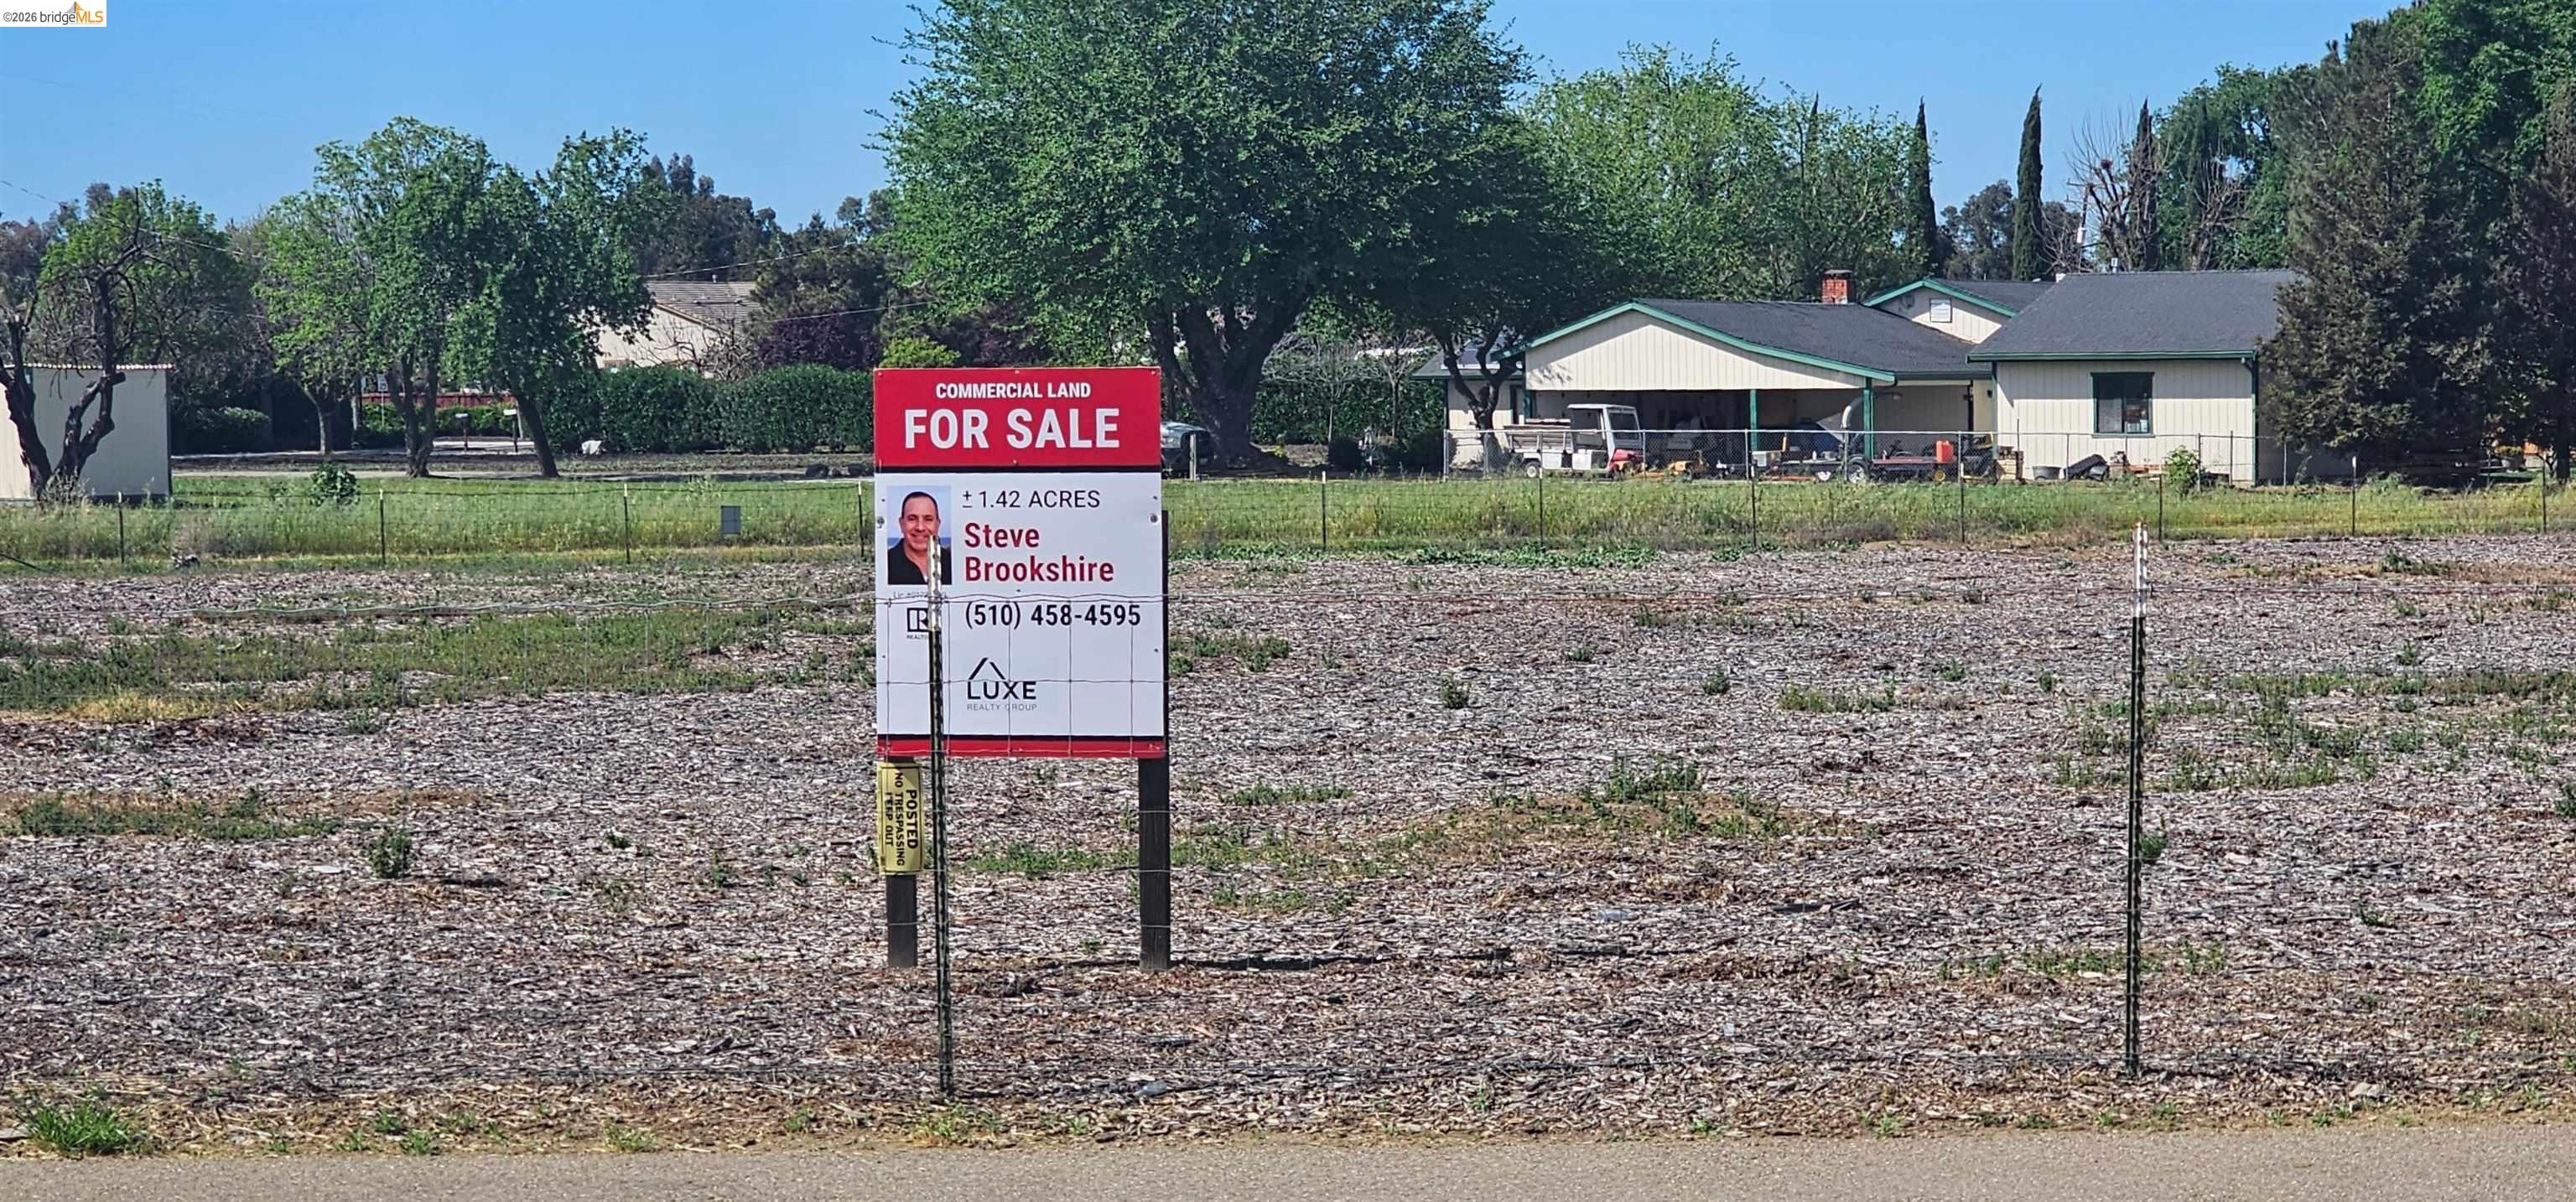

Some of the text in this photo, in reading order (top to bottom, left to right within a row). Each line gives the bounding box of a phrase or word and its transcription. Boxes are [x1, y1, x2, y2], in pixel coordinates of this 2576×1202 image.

[935, 382, 1091, 399] COMMERCIAL LAND
[904, 407, 1120, 449] FOR SALE
[1028, 490, 1101, 509] ACRES
[964, 522, 1040, 548] Steve
[965, 555, 1114, 582] Brookshire
[965, 601, 1141, 629] (510) 458-4595
[967, 681, 1036, 700] LUXE
[895, 772, 905, 866] NO TRESPASSING
[906, 790, 919, 849] POSTED
[885, 826, 894, 847] OUT
